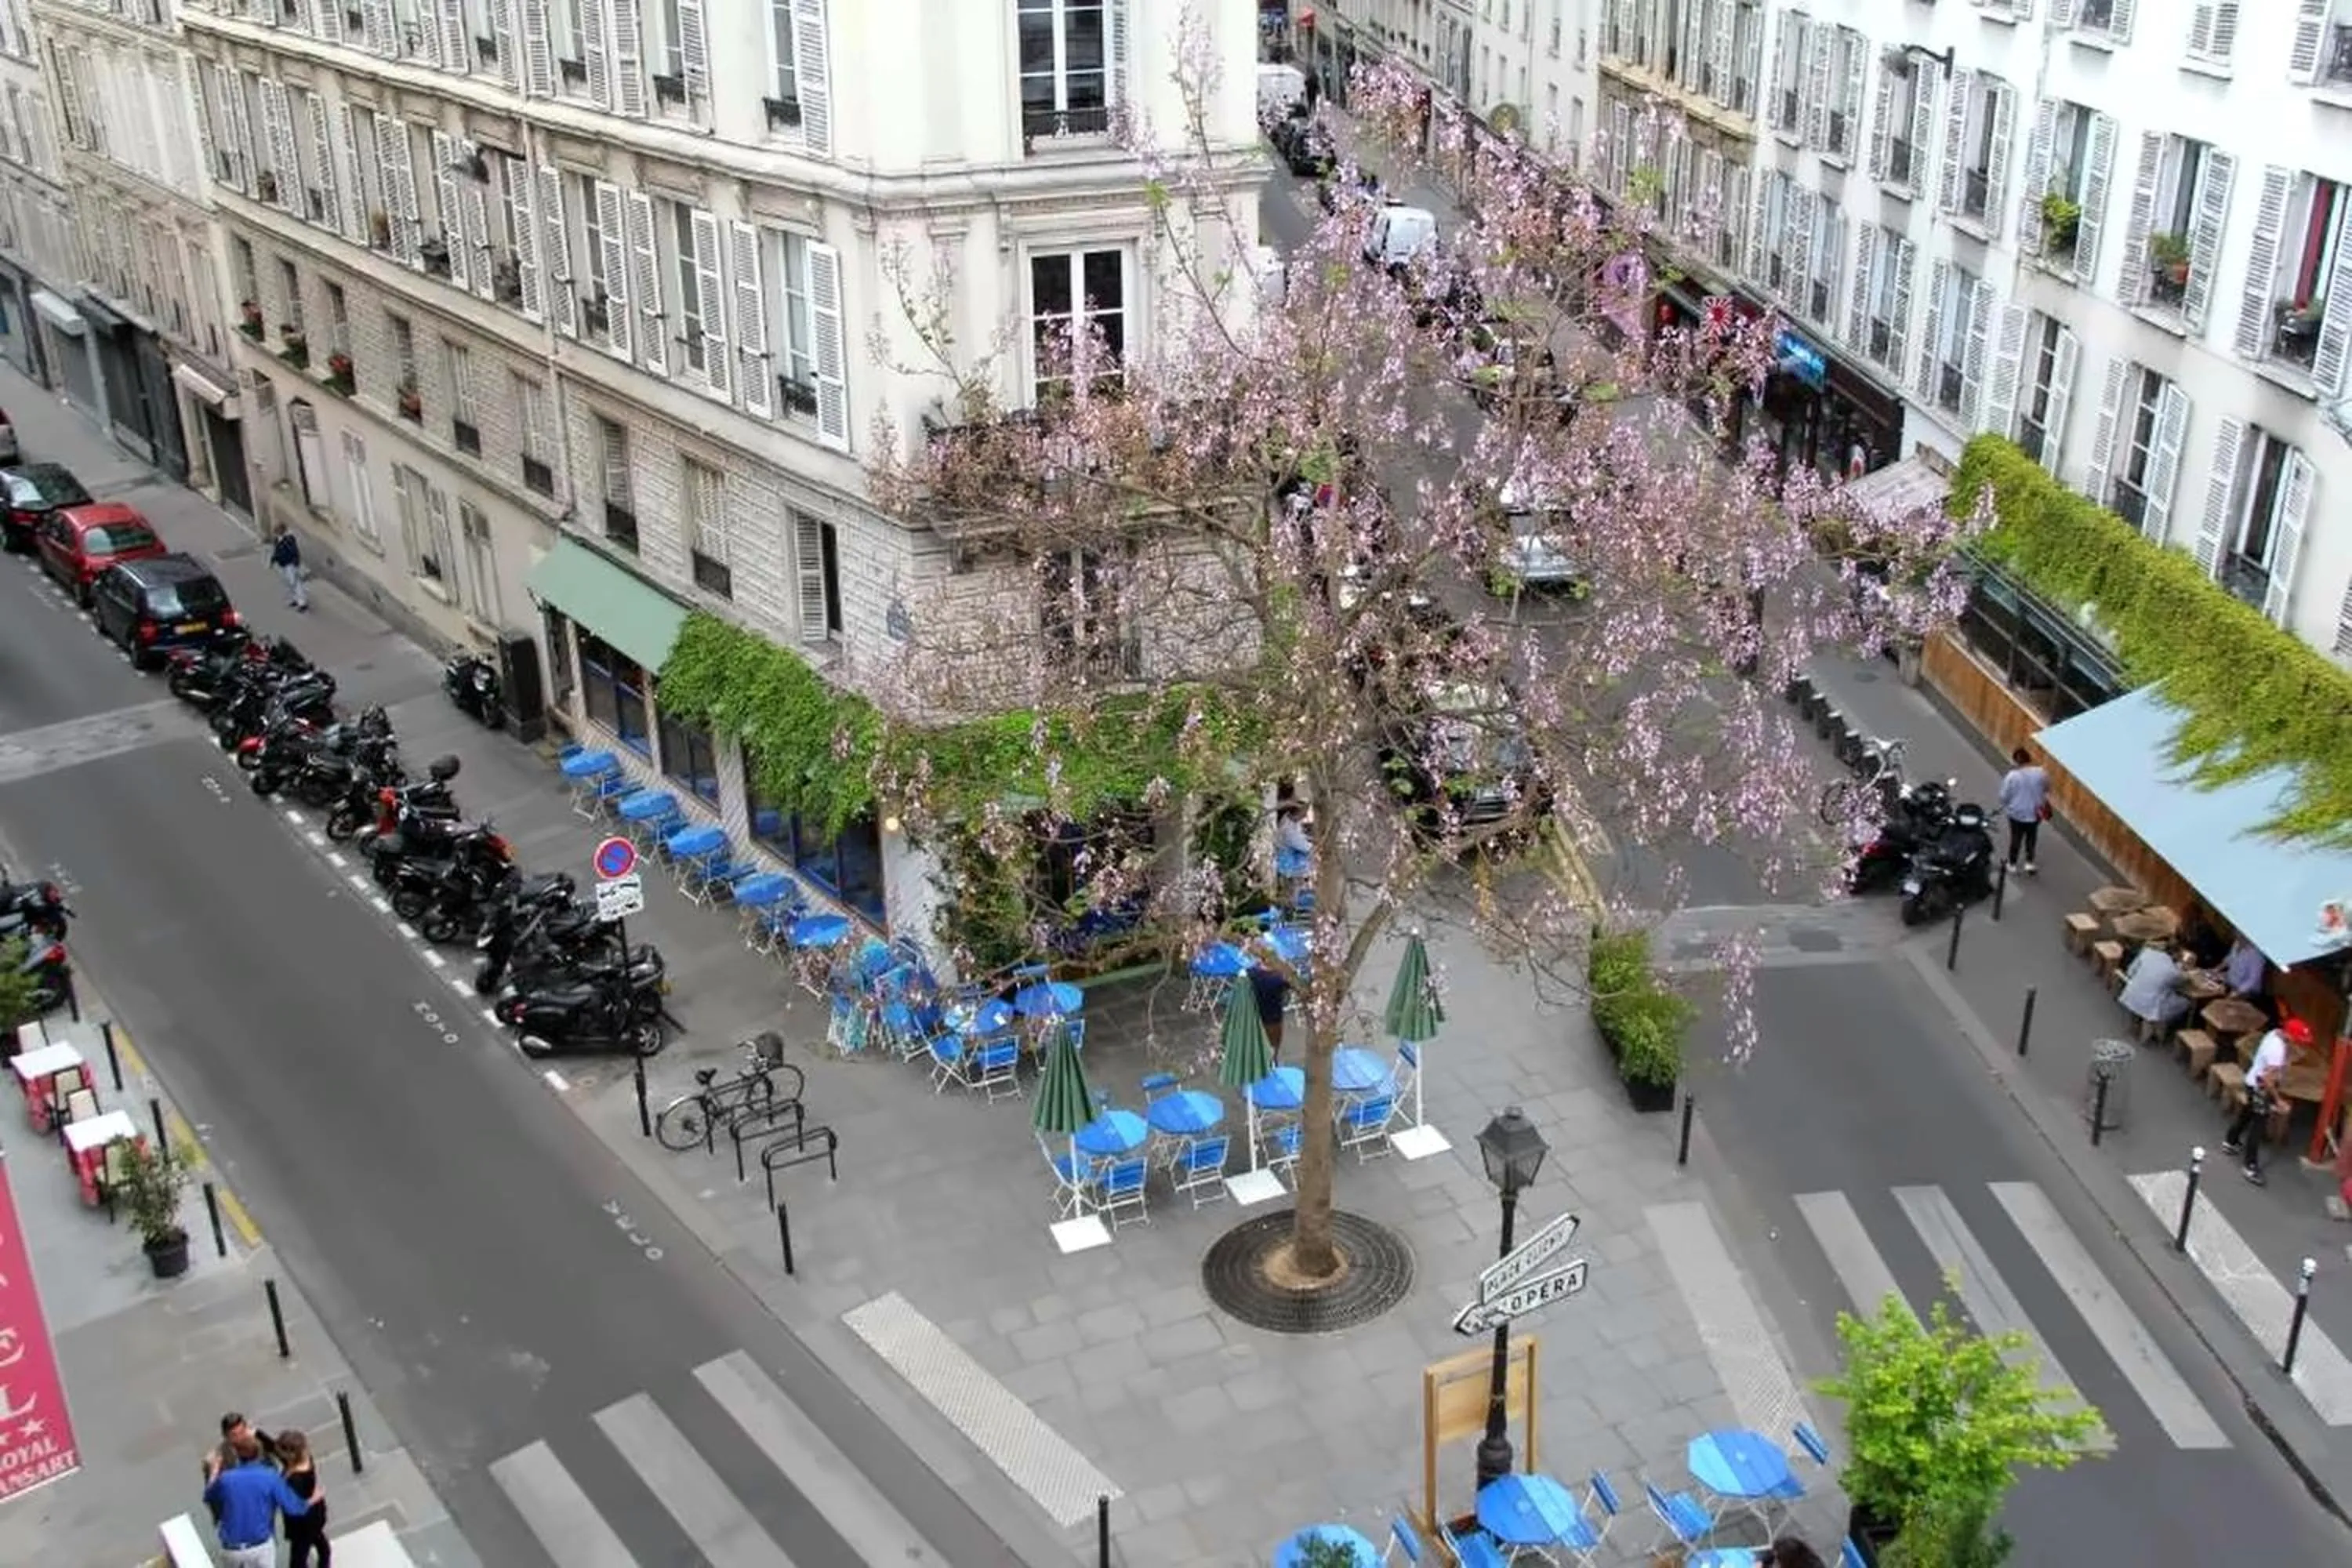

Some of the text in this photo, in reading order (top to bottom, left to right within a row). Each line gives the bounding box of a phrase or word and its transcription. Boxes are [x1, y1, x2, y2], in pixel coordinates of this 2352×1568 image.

[1511, 1272, 1577, 1311] OPÉRA
[0, 1436, 59, 1475] OYAL
[0, 1450, 75, 1494] ANSART
